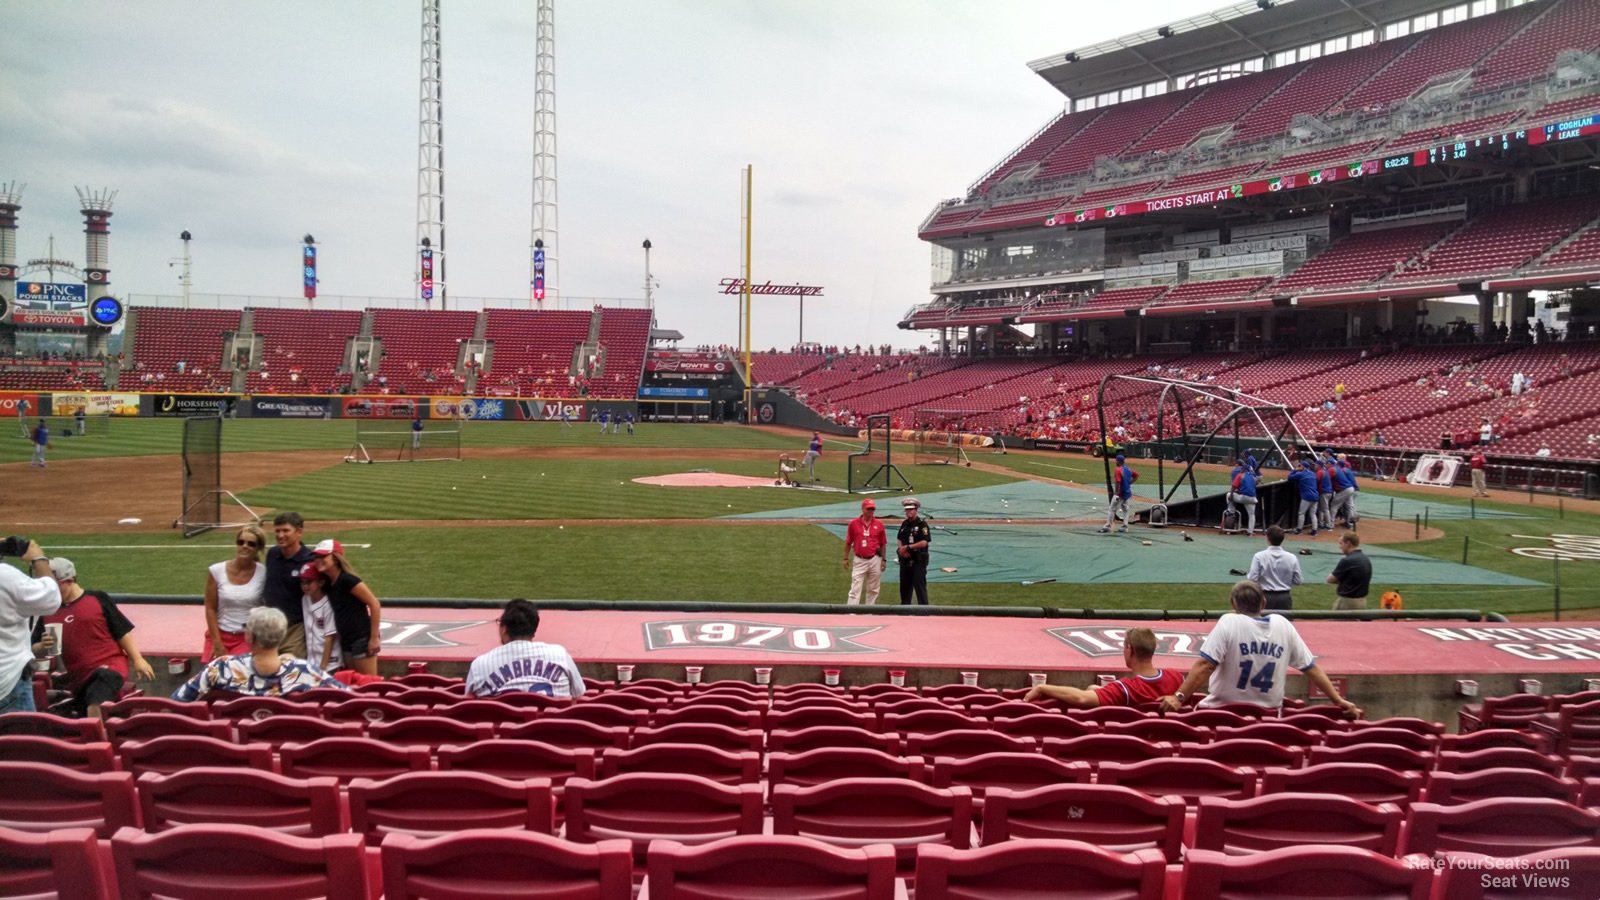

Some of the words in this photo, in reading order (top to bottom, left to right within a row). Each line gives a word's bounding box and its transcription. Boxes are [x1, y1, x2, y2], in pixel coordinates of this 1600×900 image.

[1559, 117, 1593, 131] COGHLAN
[1558, 130, 1580, 140] LEAKE
[1429, 148, 1437, 156] W
[1384, 156, 1409, 168] 6:02:26
[1146, 197, 1184, 212] TICKETS
[1185, 191, 1214, 206] START
[1216, 189, 1229, 201] AT
[43, 284, 74, 296] PNC
[720, 278, 824, 296] Budweiser
[39, 315, 75, 323] TOYOTA
[177, 400, 222, 408] HORSESHO
[662, 622, 832, 650] 1970
[1238, 642, 1284, 660] BANKS
[1236, 659, 1277, 694] 14
